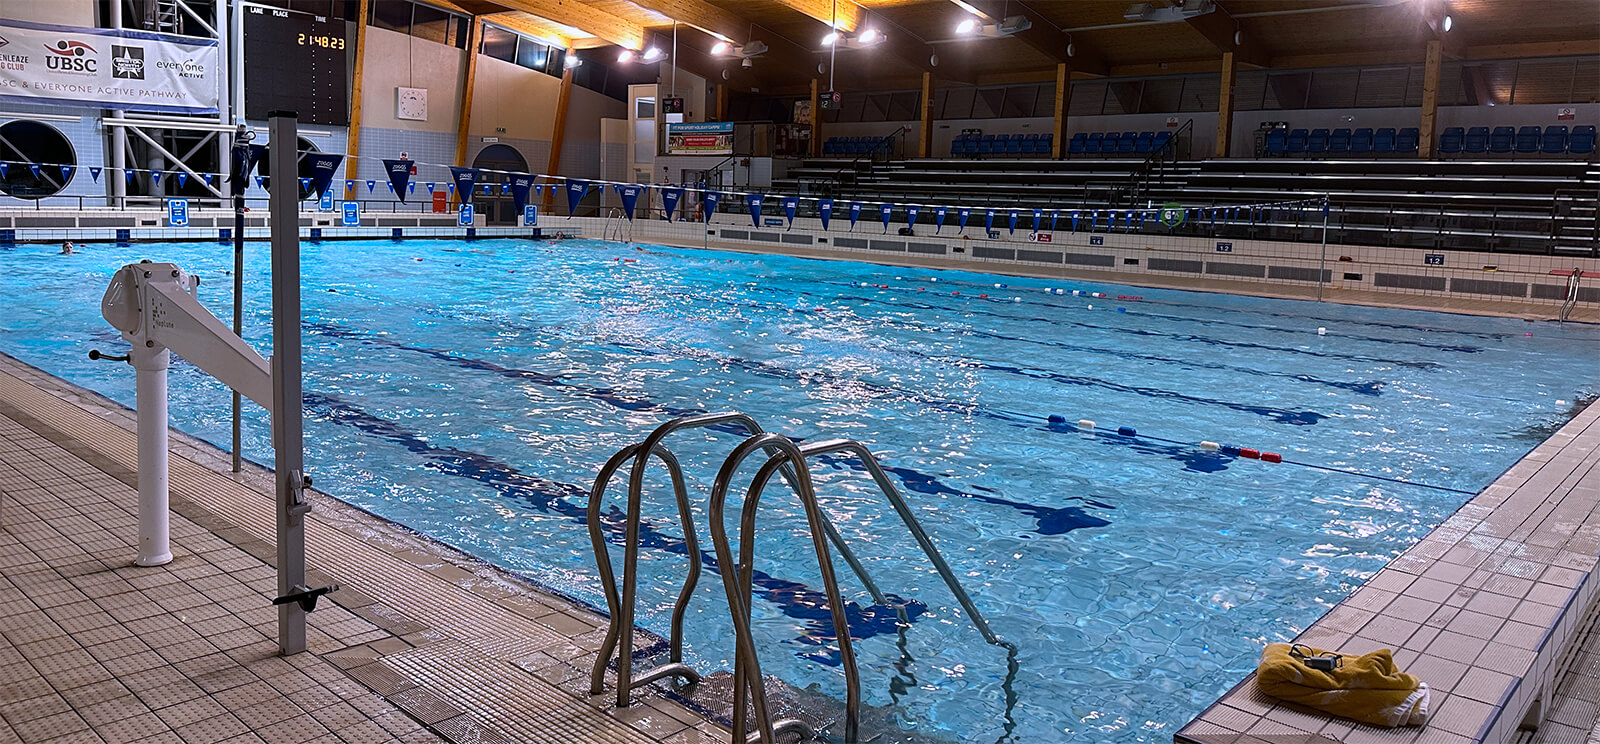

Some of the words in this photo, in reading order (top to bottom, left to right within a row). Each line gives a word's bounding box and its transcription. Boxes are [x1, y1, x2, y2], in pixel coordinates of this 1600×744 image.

[7, 62, 25, 71] CLUB
[45, 56, 98, 73] UBSC
[156, 58, 204, 72] everyone
[22, 81, 29, 89] &
[34, 81, 92, 93] EVERYONE
[97, 87, 135, 96] ACTIVE
[139, 89, 187, 99] PATHWAY
